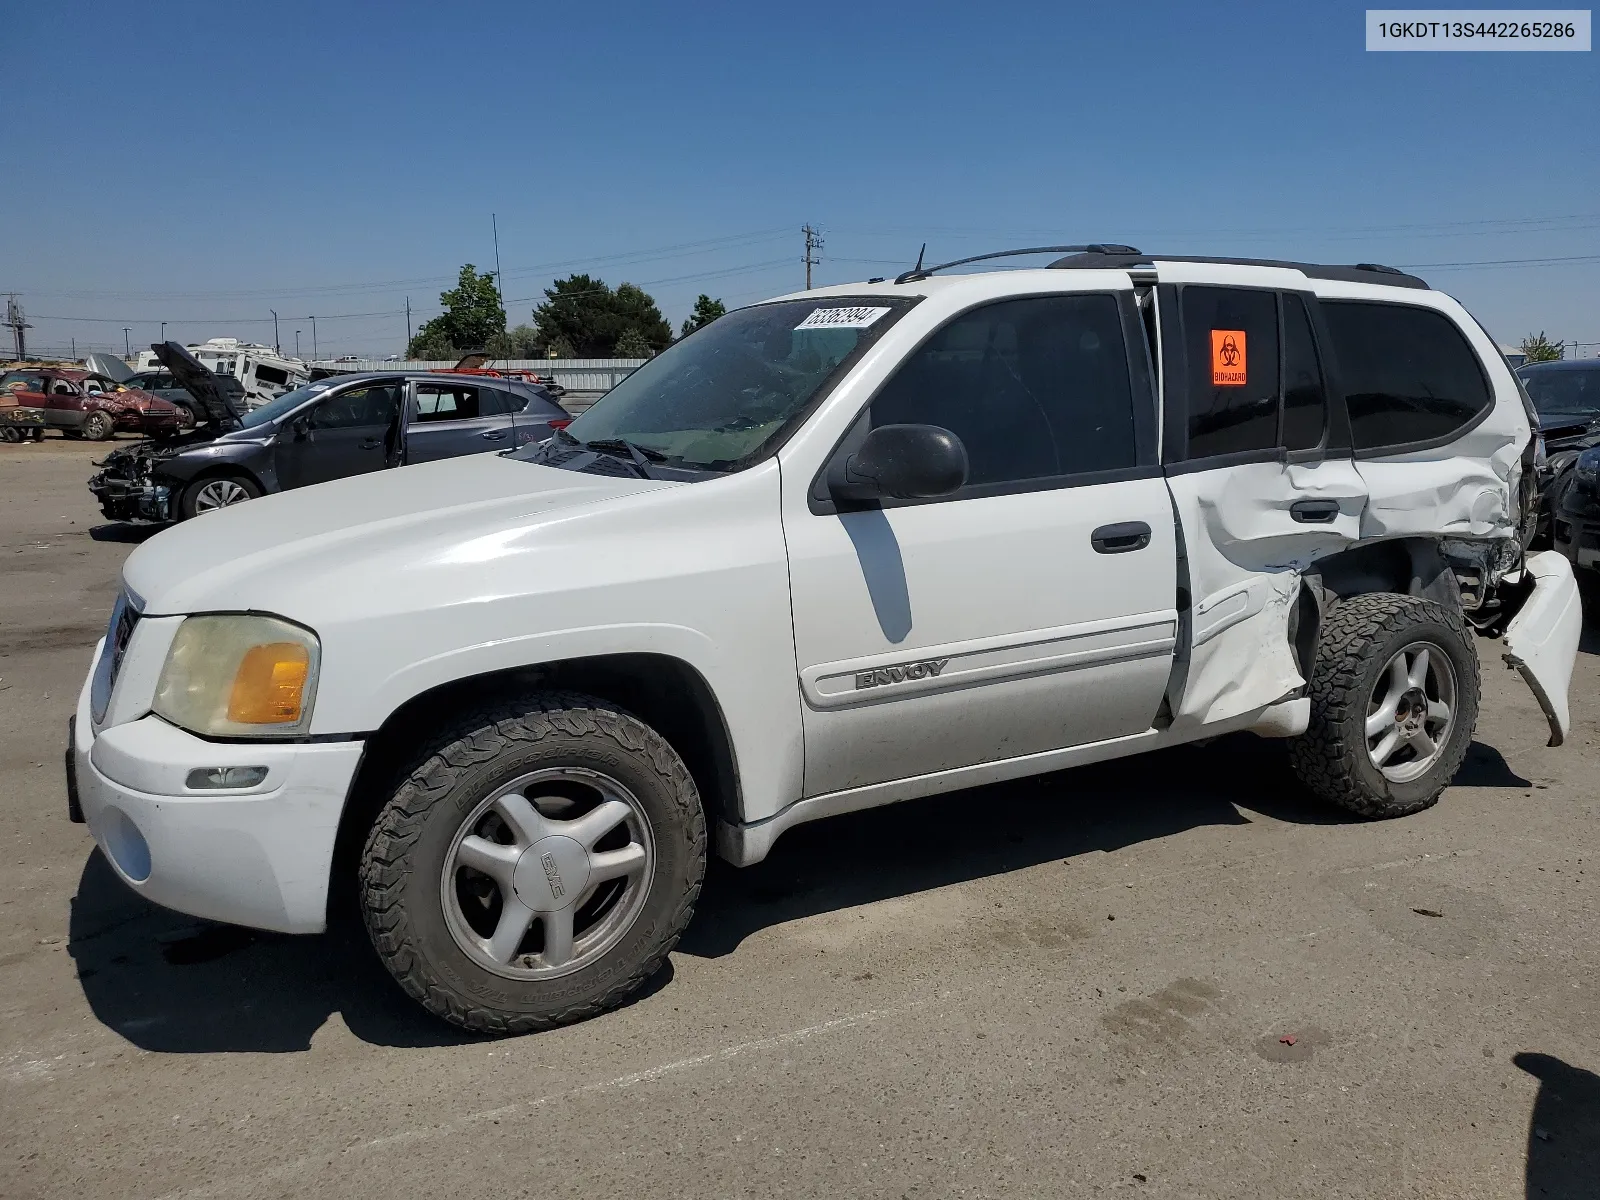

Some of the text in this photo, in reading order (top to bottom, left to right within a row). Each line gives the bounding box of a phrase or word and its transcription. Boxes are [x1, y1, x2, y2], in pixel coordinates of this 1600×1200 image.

[1214, 371, 1246, 382] BIOHAZARD
[855, 658, 949, 690] ENVOY
[540, 851, 565, 899] GMC
